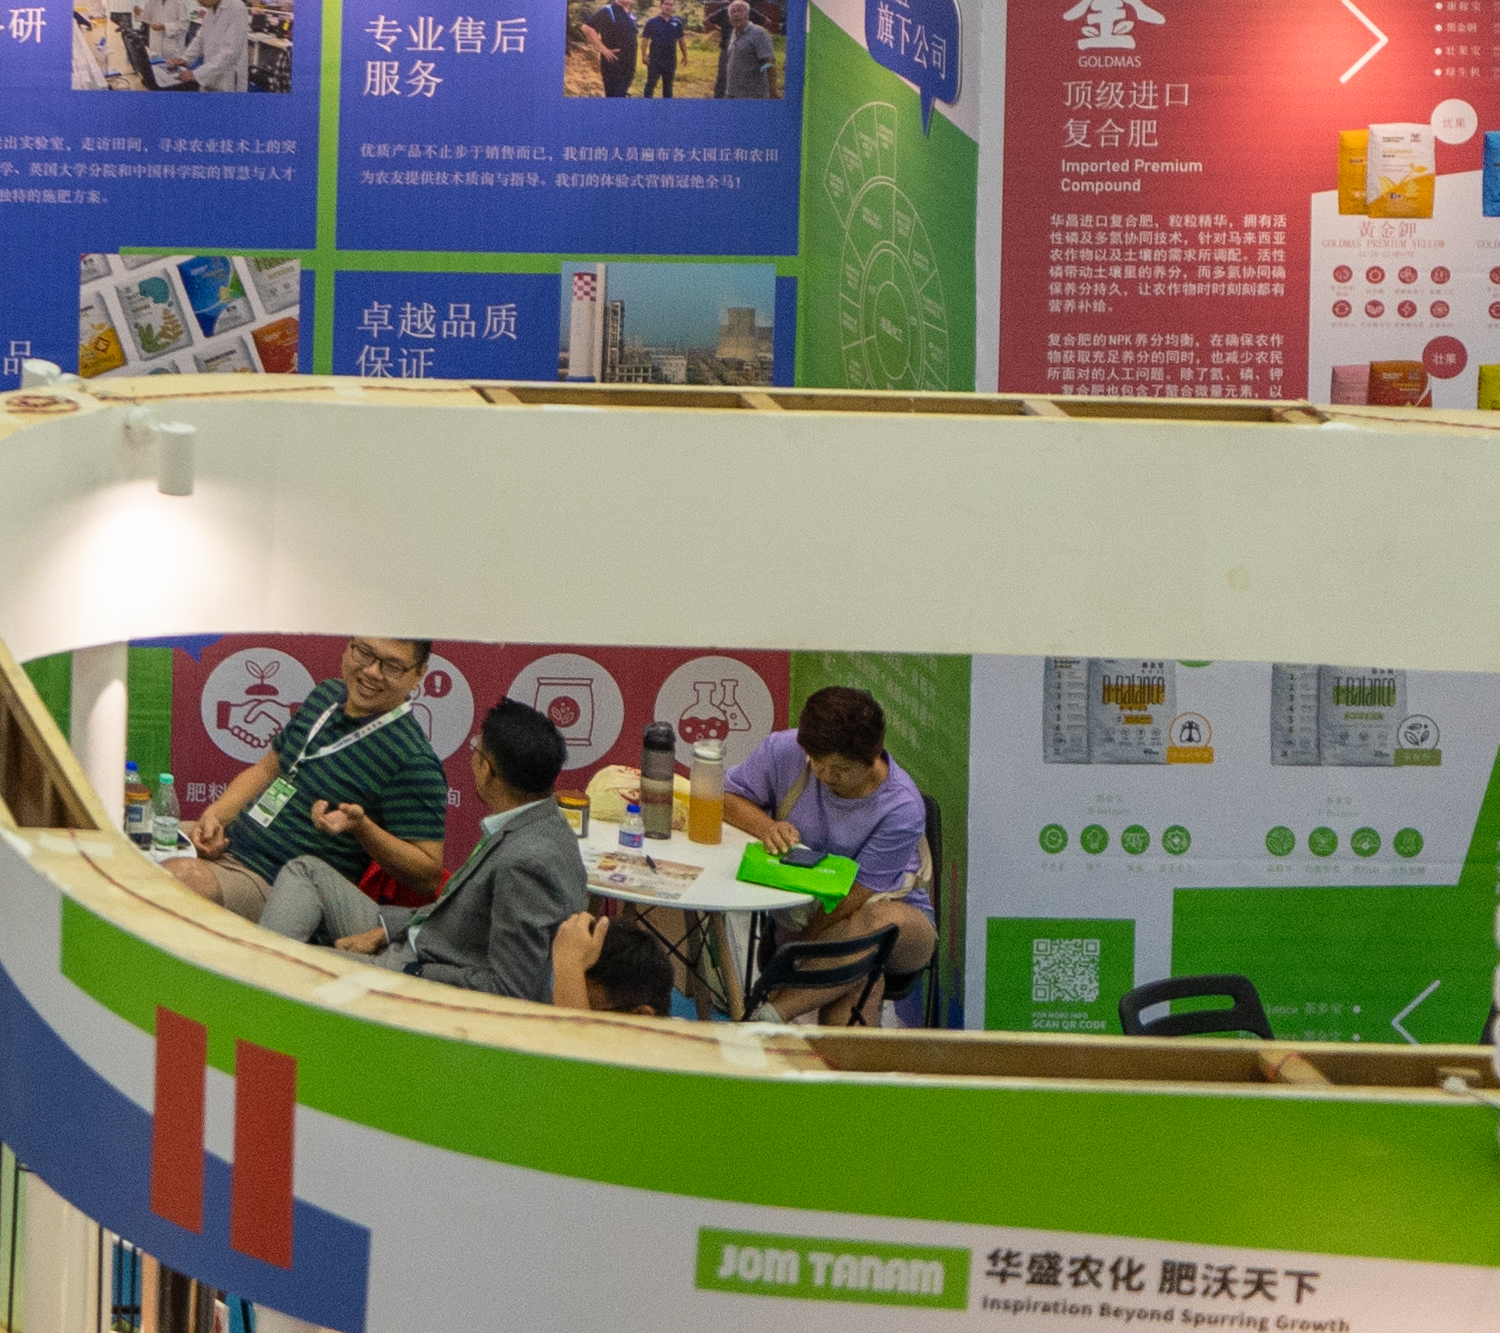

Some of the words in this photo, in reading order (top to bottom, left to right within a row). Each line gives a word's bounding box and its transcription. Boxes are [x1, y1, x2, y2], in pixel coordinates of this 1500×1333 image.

[362, 15, 529, 56] 专业售后
[876, 0, 948, 81] 旗下公司
[362, 59, 444, 100] 服务
[1078, 55, 1142, 69] GOLDMAS
[1062, 80, 1190, 110] 顶级进口
[1062, 119, 1159, 149] 复合肥
[1061, 158, 1129, 174] Imported
[1134, 159, 1203, 173] Premium
[1060, 179, 1141, 194] Compound
[356, 301, 519, 341] 卓越品质
[717, 1243, 801, 1284] JOM
[807, 1250, 945, 1296] TANAM
[982, 1247, 1147, 1294] 华盛农化
[1157, 1258, 1321, 1307] 肥沃天下
[981, 1294, 1094, 1320] Inspiration
[1100, 1302, 1177, 1326] Beyond
